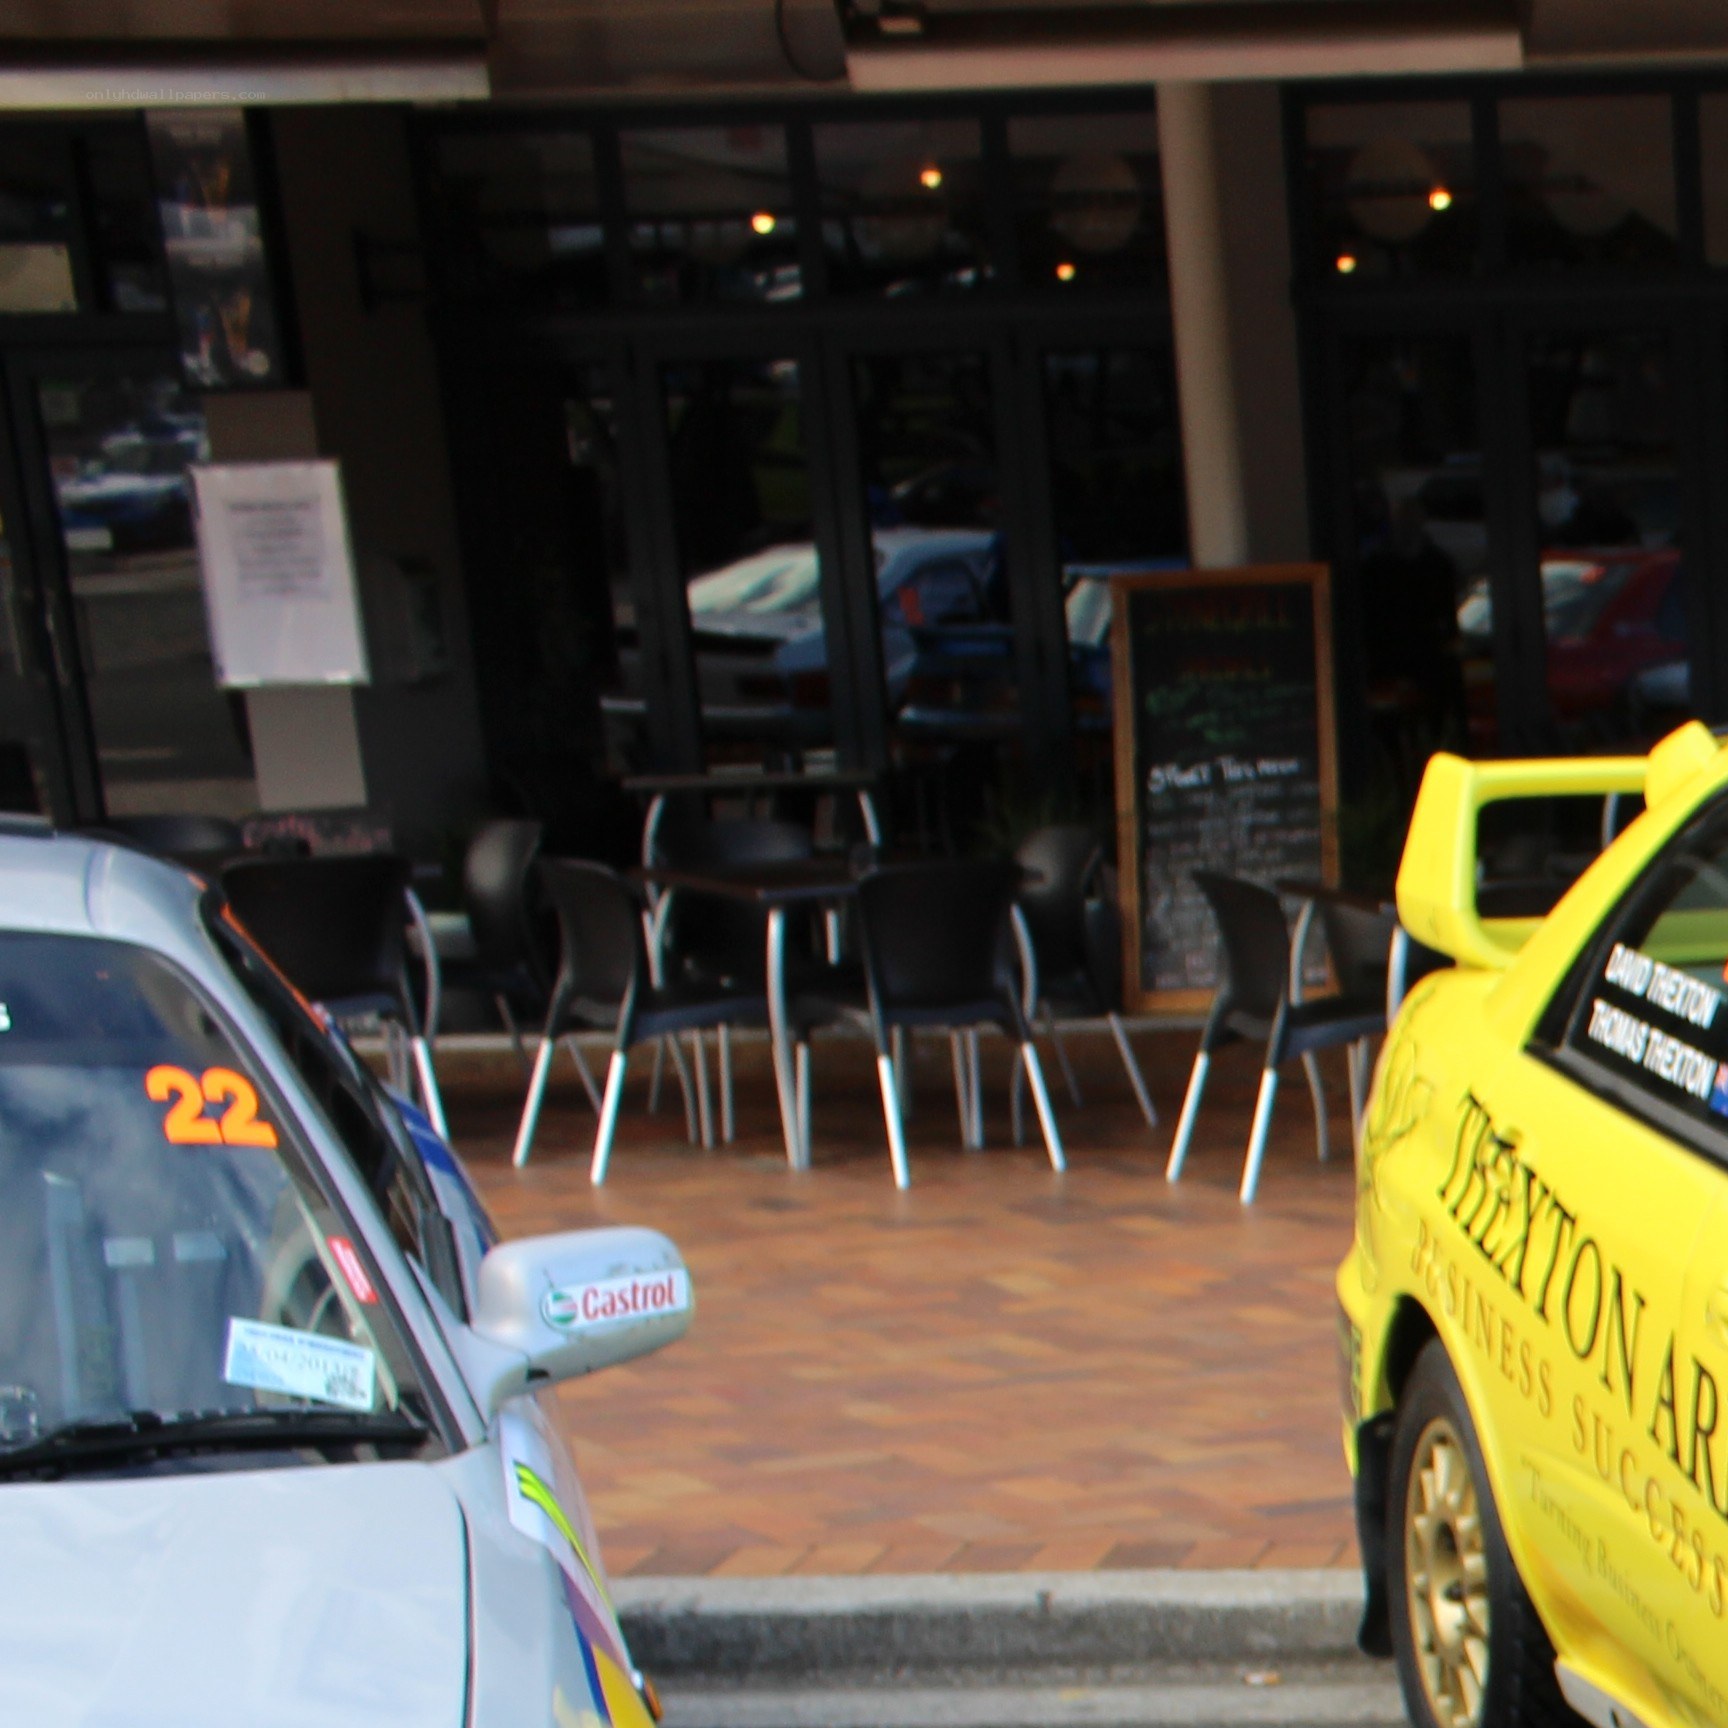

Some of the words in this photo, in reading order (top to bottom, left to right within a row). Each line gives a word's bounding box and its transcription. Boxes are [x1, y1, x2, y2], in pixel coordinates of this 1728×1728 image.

[1603, 941, 1654, 998] DAVID
[1646, 960, 1723, 1031] THEXTON
[1587, 997, 1650, 1064] THOMAS
[1643, 1025, 1719, 1101] THEXTON
[145, 1065, 279, 1148] 22
[1437, 1092, 1649, 1400] THEXTON
[581, 1277, 678, 1323] Castrol
[1408, 1217, 1554, 1417] BUSINESS
